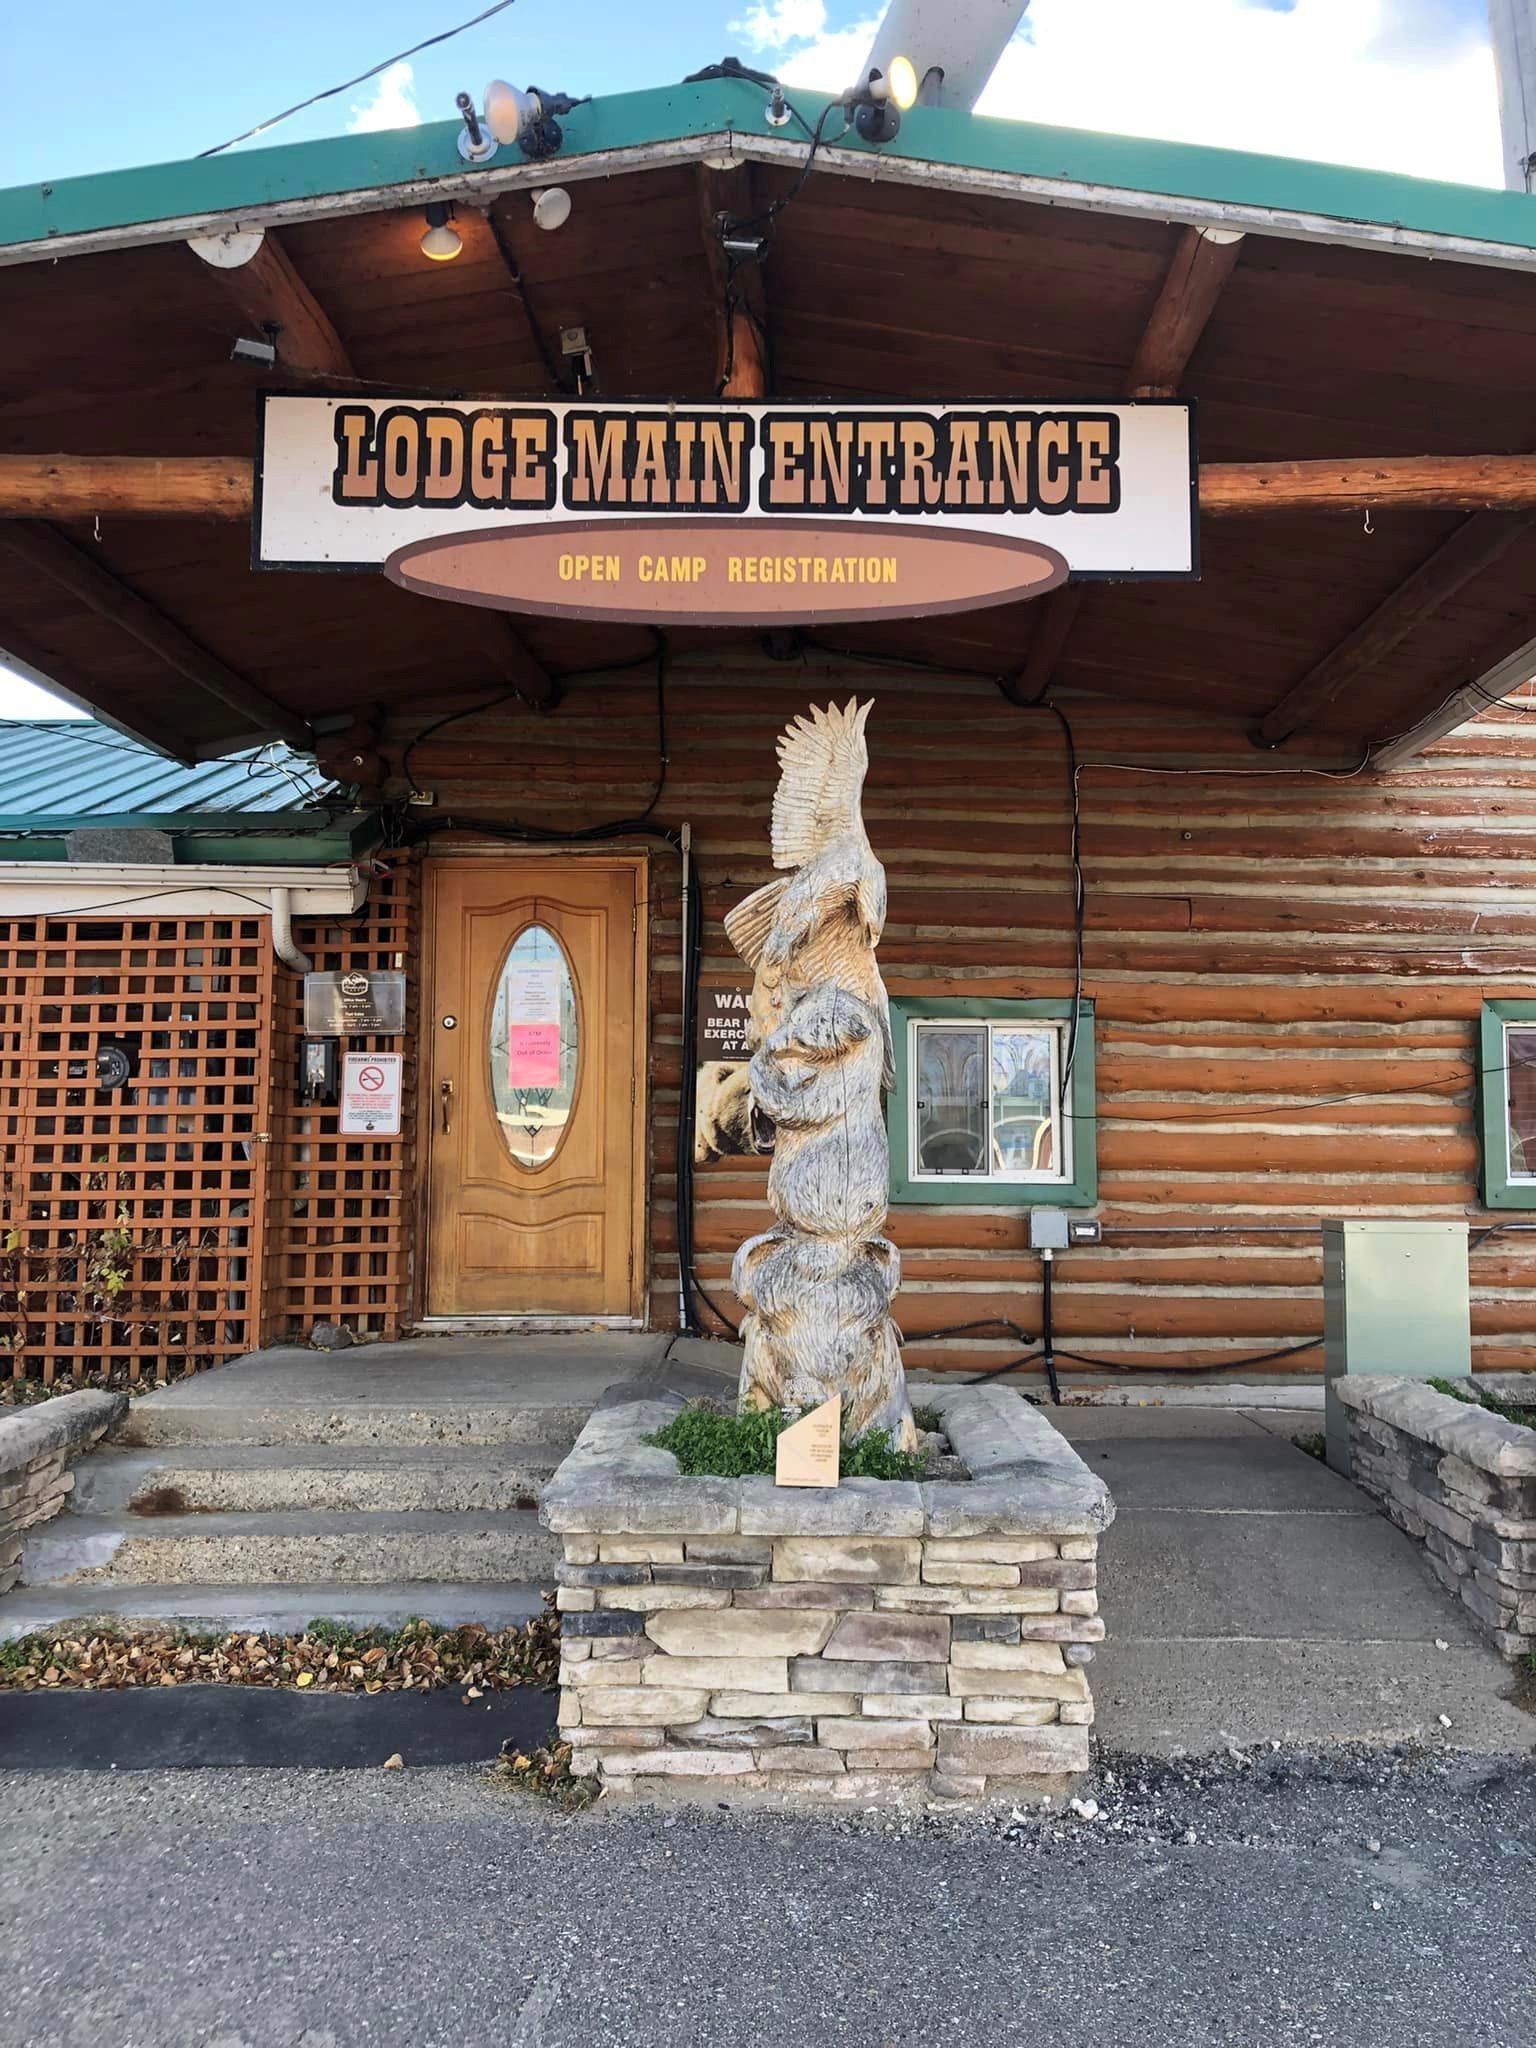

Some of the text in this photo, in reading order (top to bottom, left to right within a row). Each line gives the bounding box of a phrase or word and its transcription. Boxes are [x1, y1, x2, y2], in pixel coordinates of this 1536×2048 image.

[338, 411, 1114, 508] LODGE MAIN ENTRANCE
[558, 553, 897, 584] OPEN CAMP REGISTRATION
[707, 1017, 740, 1028] BEAR
[704, 1029, 746, 1039] EXERC
[722, 1040, 738, 1050] AT
